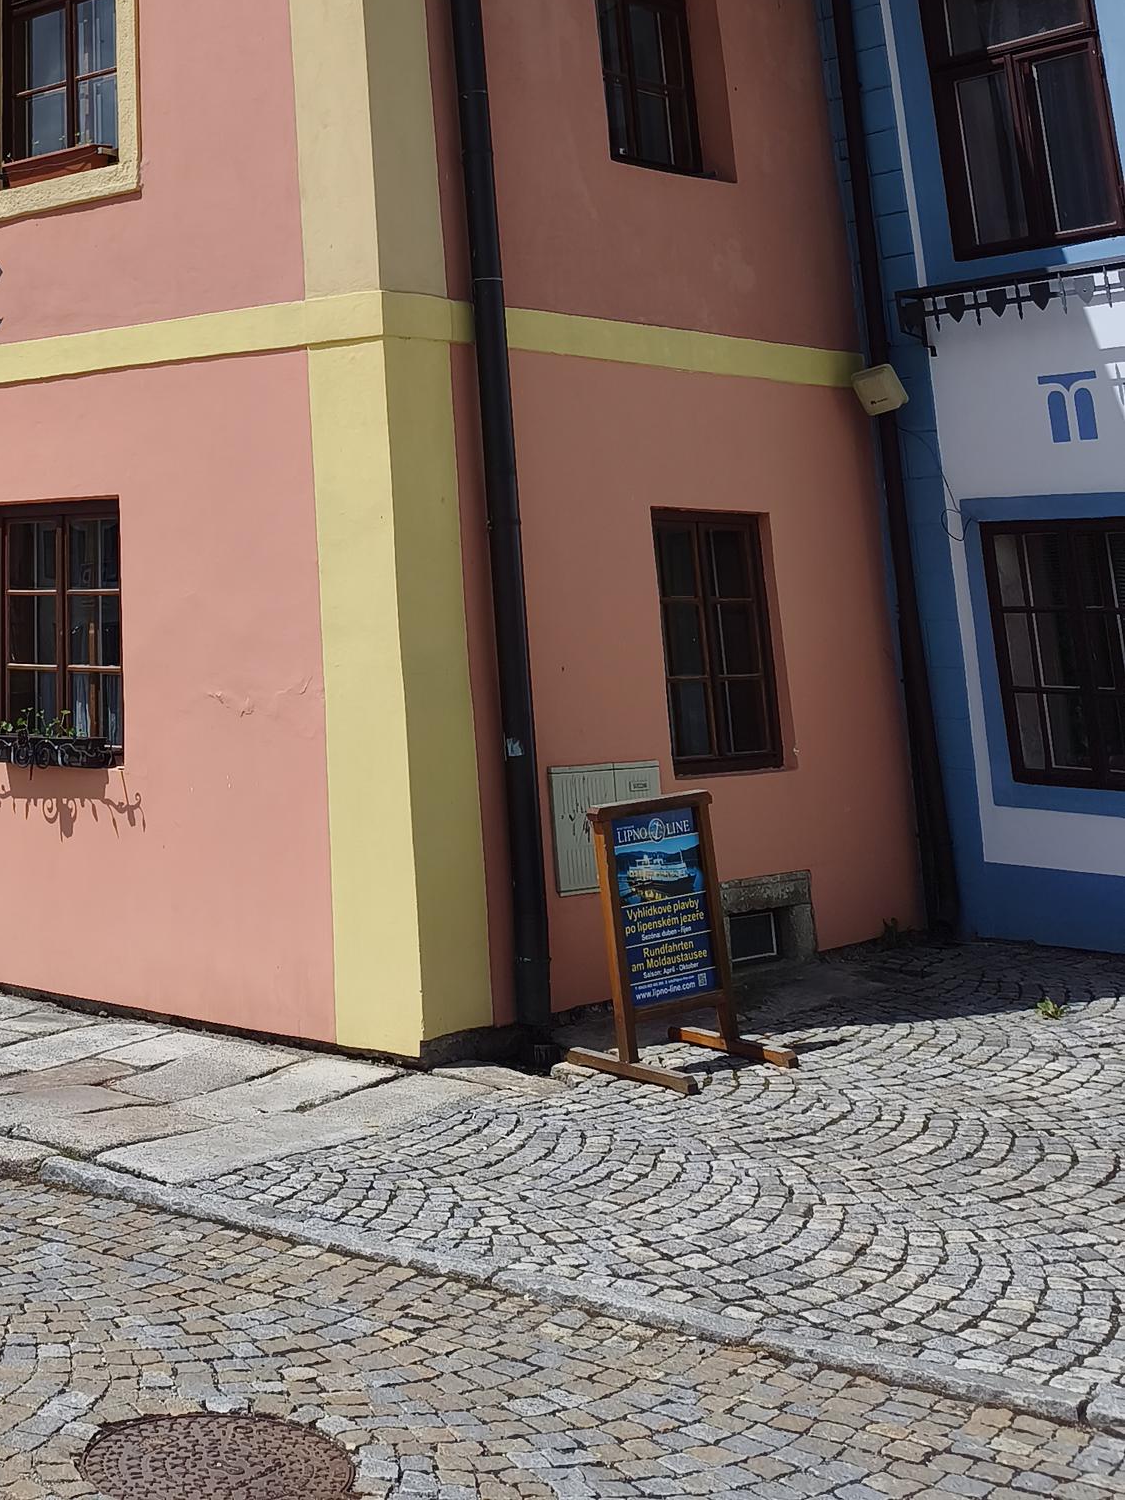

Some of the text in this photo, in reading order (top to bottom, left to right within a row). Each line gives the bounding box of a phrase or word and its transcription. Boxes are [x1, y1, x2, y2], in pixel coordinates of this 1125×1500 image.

[617, 819, 691, 844] LIPNO LINE
[626, 898, 700, 921] Vyhlídkové plavby
[625, 910, 705, 937] po lipenském jezeře
[642, 940, 694, 958] Rundfahrten
[631, 949, 708, 973] am Moldaustausee
[635, 981, 696, 1000] www.lipno-line.com
